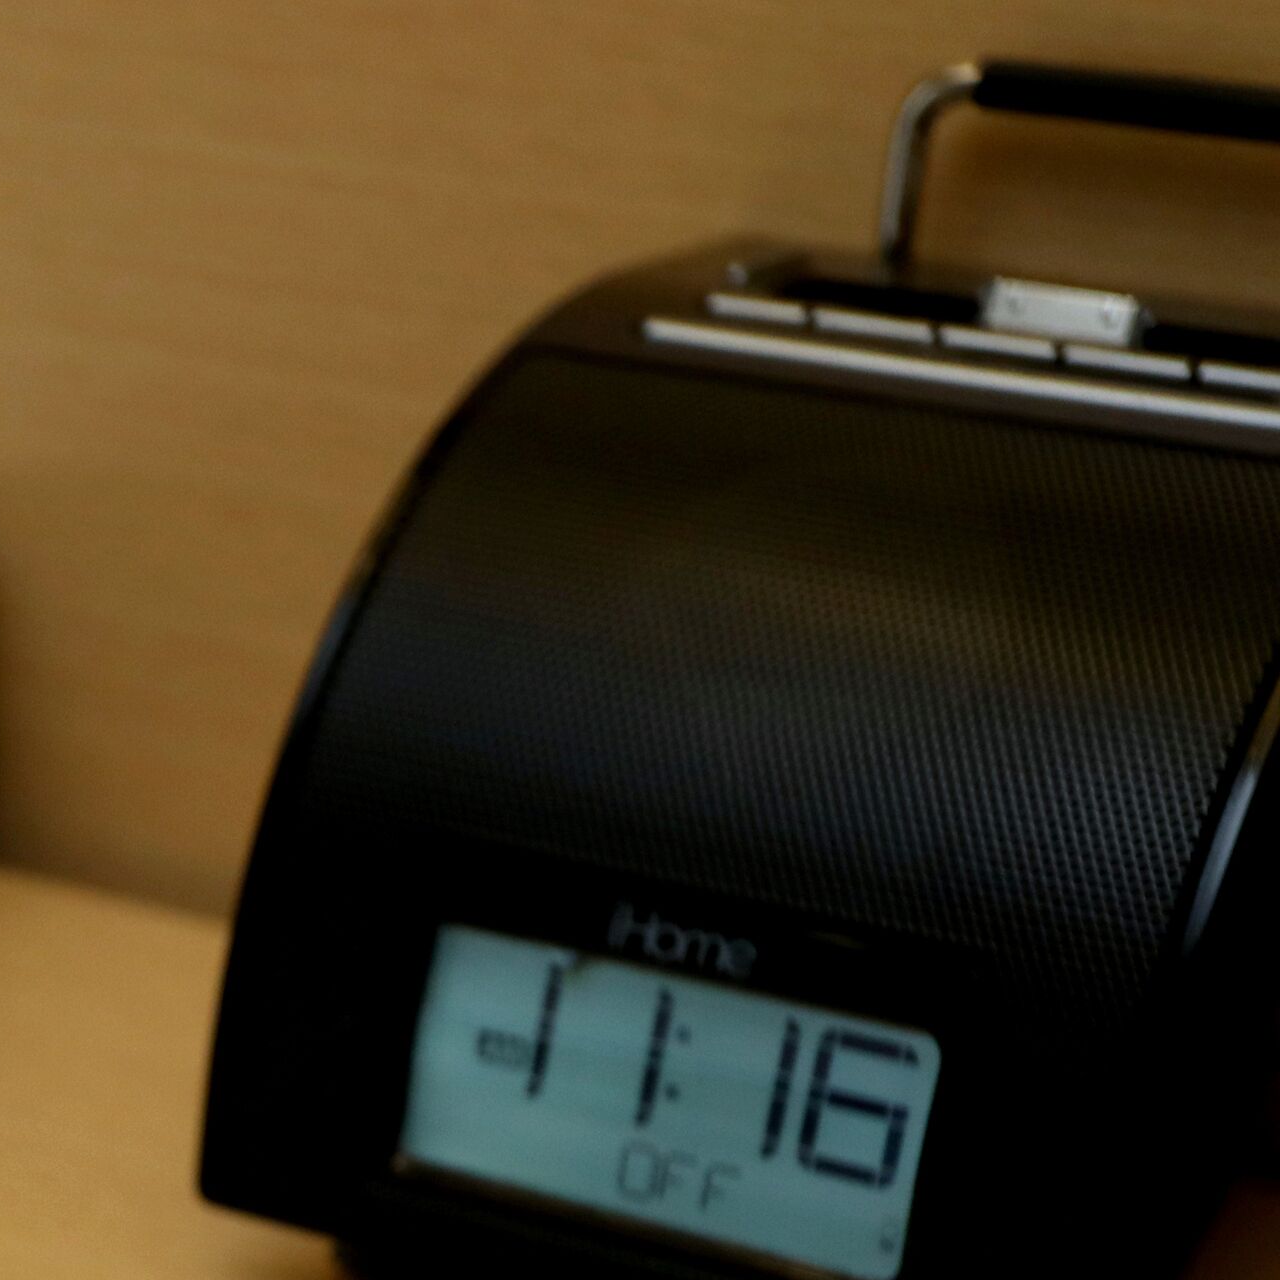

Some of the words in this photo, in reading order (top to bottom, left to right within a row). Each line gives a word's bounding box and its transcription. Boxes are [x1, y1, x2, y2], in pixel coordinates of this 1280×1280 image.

[607, 900, 758, 979] iHome
[526, 955, 919, 1190] 11:16
[617, 1141, 742, 1212] OFF
